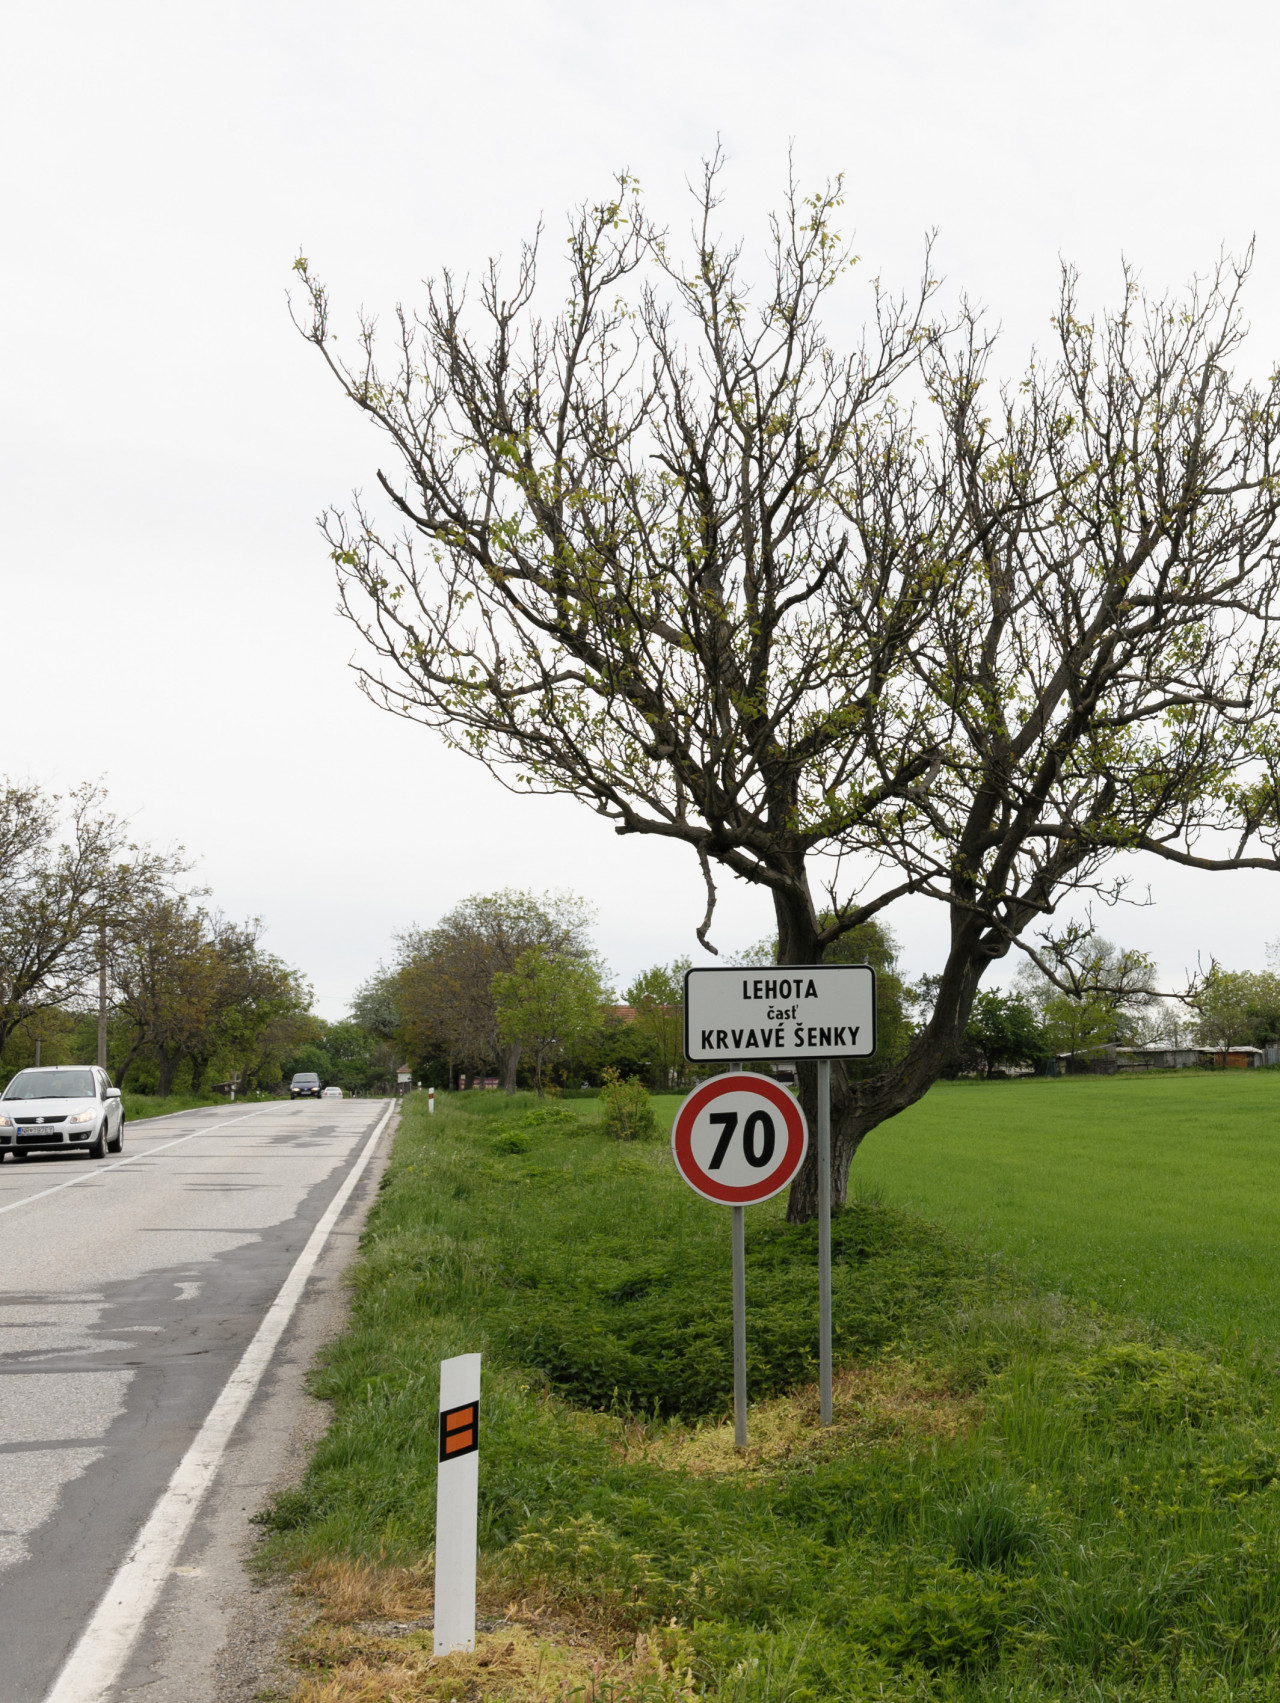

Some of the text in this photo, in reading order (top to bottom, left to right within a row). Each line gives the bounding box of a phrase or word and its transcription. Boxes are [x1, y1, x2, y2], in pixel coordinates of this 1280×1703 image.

[743, 979, 818, 1000] LEHOTA
[767, 1004, 799, 1020] časť
[701, 1022, 860, 1050] KRVAVÉ ŠENKY
[708, 1110, 775, 1170] 70
